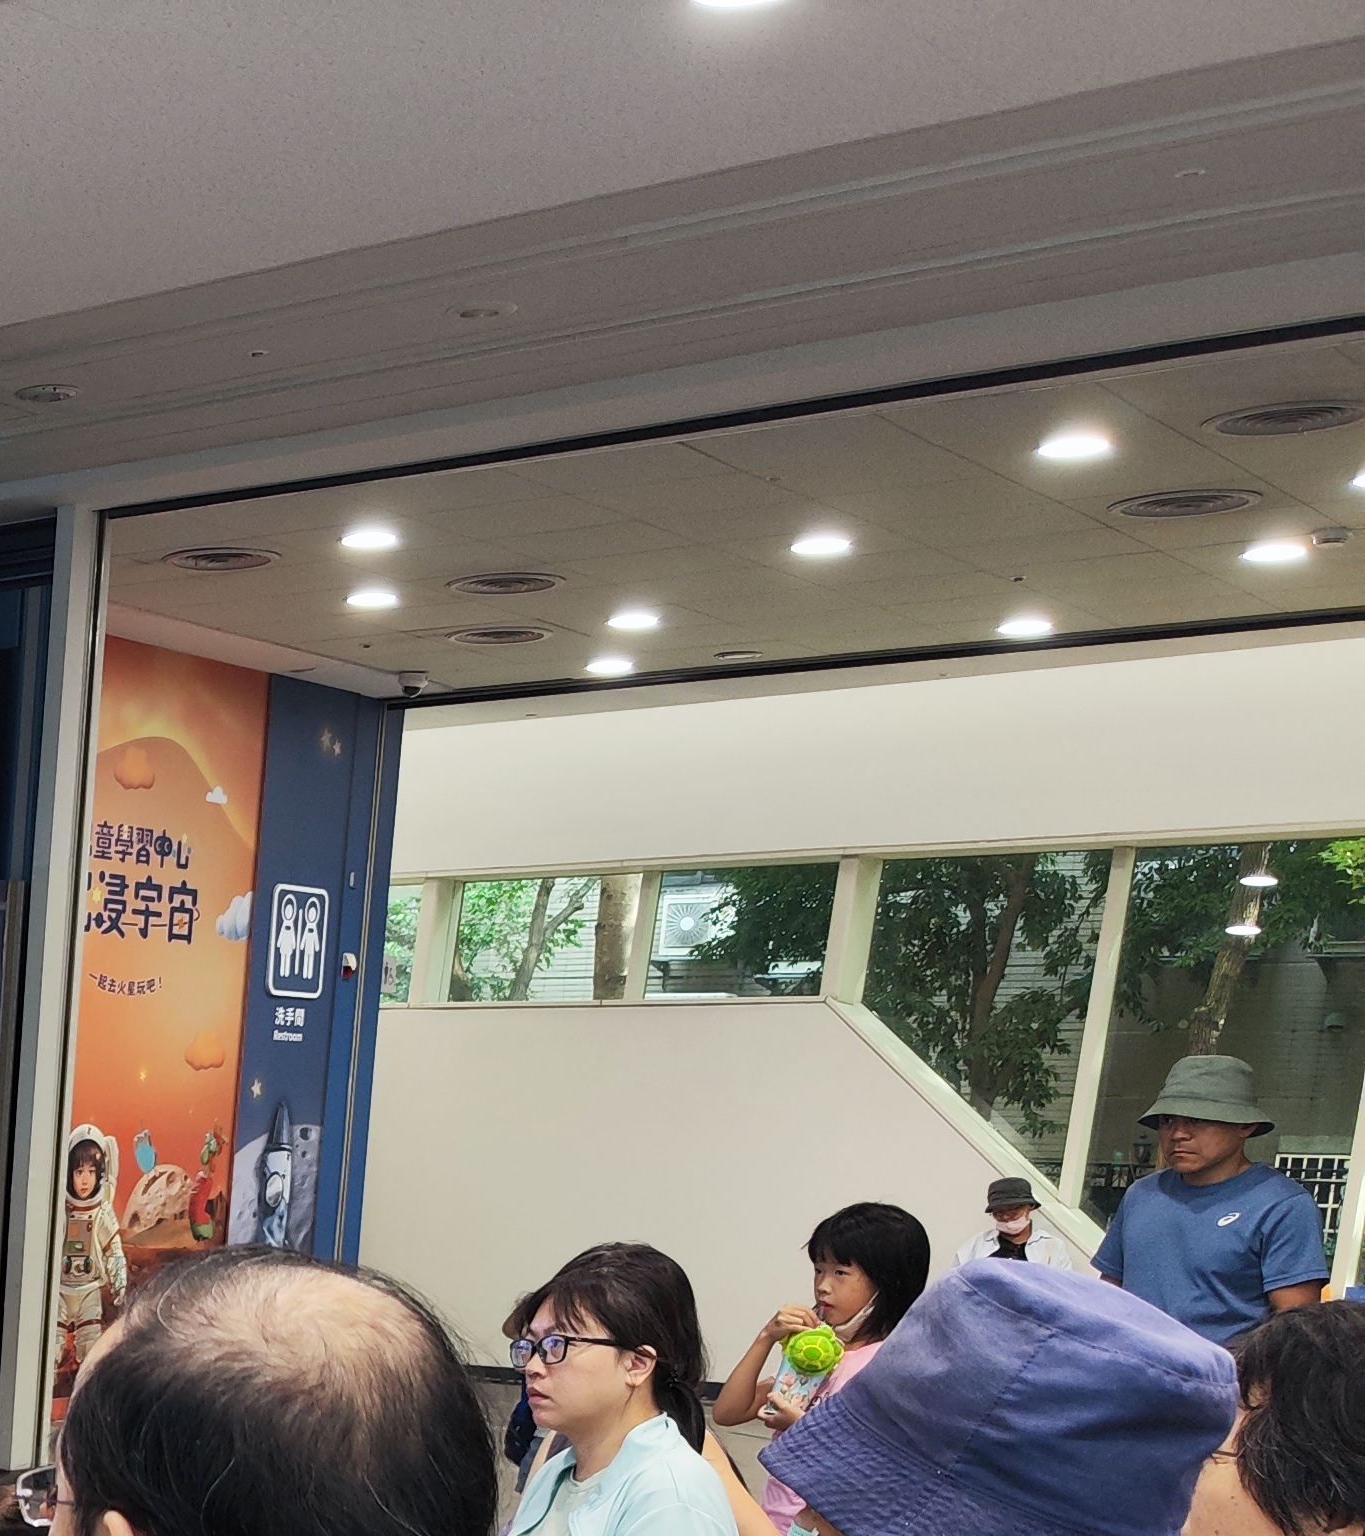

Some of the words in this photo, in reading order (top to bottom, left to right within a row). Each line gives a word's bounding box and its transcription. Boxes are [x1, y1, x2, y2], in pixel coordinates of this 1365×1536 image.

[89, 820, 192, 870] 童學習中心
[275, 1006, 305, 1027] 洗手間
